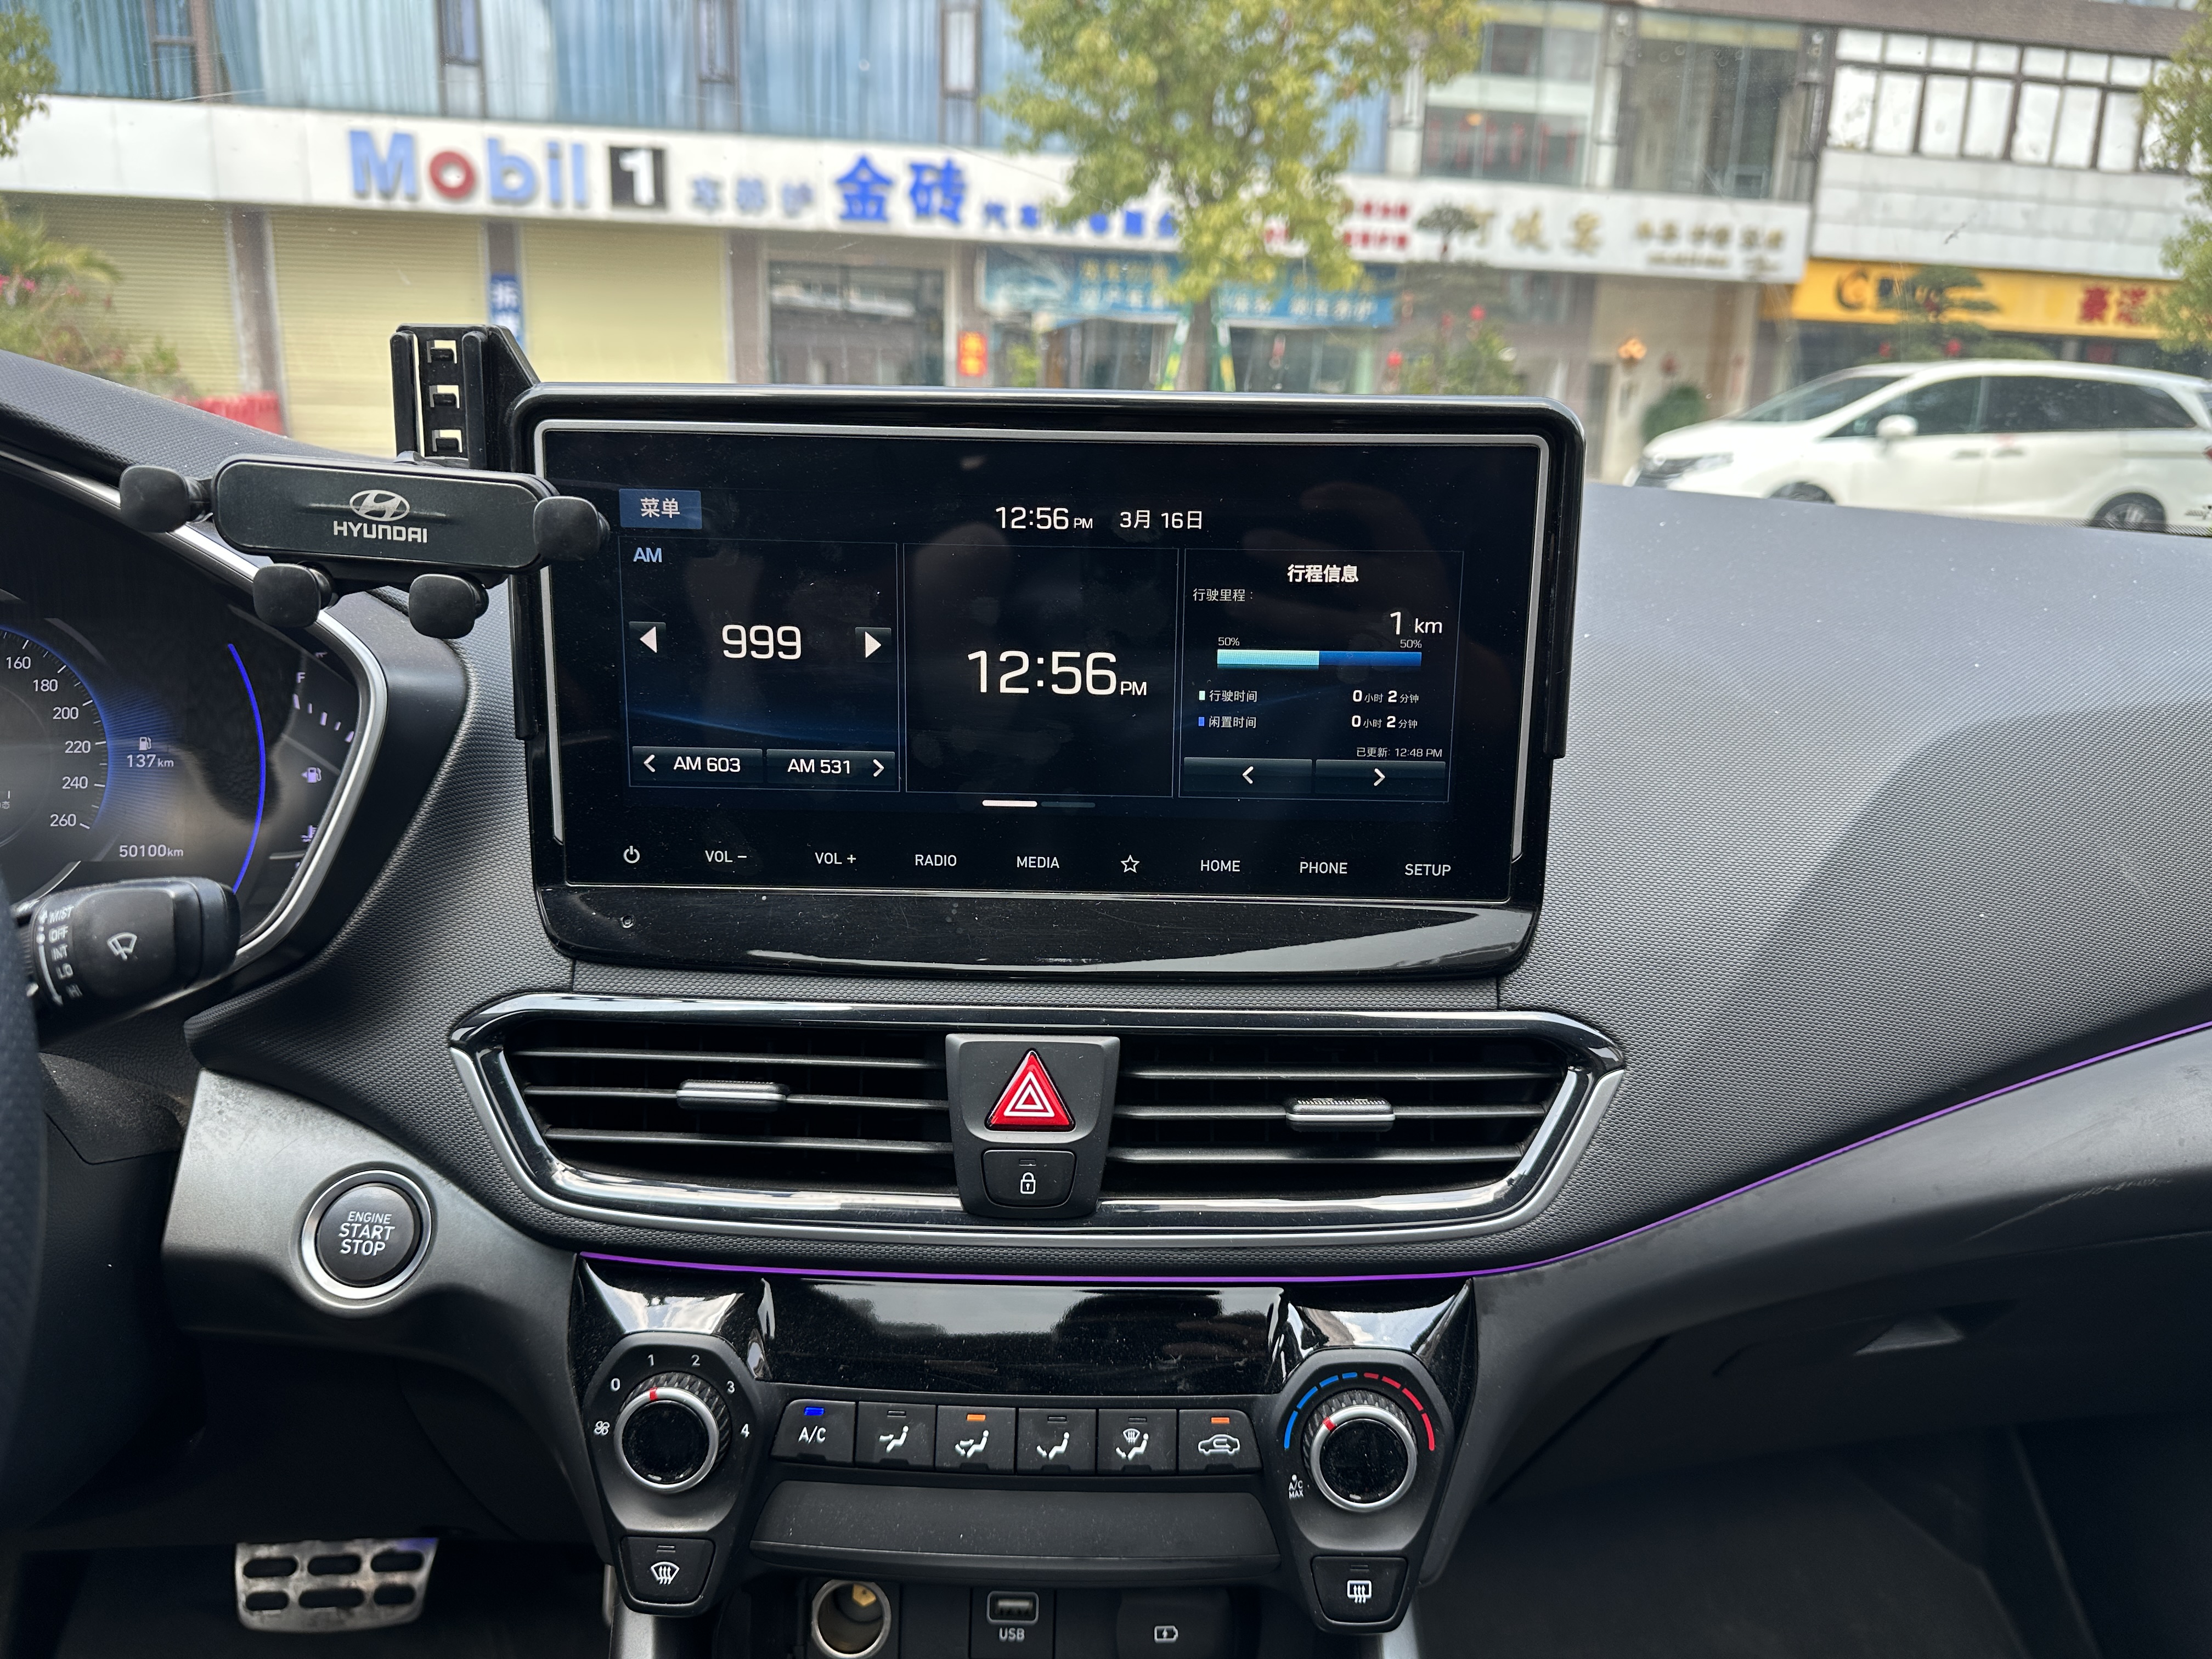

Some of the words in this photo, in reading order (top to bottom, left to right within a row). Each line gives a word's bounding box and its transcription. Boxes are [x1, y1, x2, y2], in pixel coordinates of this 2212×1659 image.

[348, 129, 588, 208] Mobil
[619, 148, 656, 207] 1
[836, 155, 964, 223] 金砖
[640, 497, 680, 518] 菜单
[995, 506, 1069, 530] 12:56
[1074, 517, 1093, 529] PM
[333, 520, 427, 543] HYUNDAI
[633, 547, 662, 563] AM
[1287, 563, 1359, 583] 行程信息
[1390, 611, 1401, 635] 1
[1414, 618, 1442, 634] km
[722, 624, 802, 659] 999
[1218, 637, 1240, 646] 50%
[1400, 639, 1422, 648] 50%
[6, 656, 31, 669] 160
[297, 672, 306, 684] F
[33, 679, 58, 692] 180
[1209, 690, 1257, 703] 行驶时间
[53, 707, 79, 720] 200
[1209, 715, 1256, 729] 闲置时间
[65, 740, 91, 753] 220
[1395, 748, 1423, 757] 12:48
[1426, 748, 1442, 758] PM
[673, 756, 701, 770] AM
[707, 757, 741, 772] 603
[787, 758, 815, 773] AM
[820, 759, 850, 774] 531
[62, 776, 88, 789] 240
[50, 814, 76, 827] 260
[704, 850, 733, 862] VOL
[815, 852, 843, 865] VOL
[915, 854, 957, 867] RADIO
[1017, 856, 1060, 868] MEDIA
[1200, 859, 1240, 872] HOME
[1300, 861, 1348, 874] PHONE
[1404, 864, 1451, 876] SETUP
[47, 906, 74, 924] MIST
[48, 925, 69, 944] OFF
[50, 944, 68, 961] INT
[56, 963, 74, 980] LO
[66, 984, 83, 998] HI
[347, 1211, 392, 1224] ENGINE
[338, 1222, 396, 1240] START
[340, 1238, 386, 1256] STOP
[648, 1354, 654, 1366] 1
[691, 1355, 701, 1366] 2
[611, 1378, 620, 1391] 0
[727, 1380, 735, 1393] 3
[741, 1423, 750, 1437] 4
[798, 1426, 826, 1443] A/C
[1288, 1480, 1304, 1491] A/C
[1289, 1490, 1304, 1499] MAX
[999, 1628, 1025, 1641] USB
